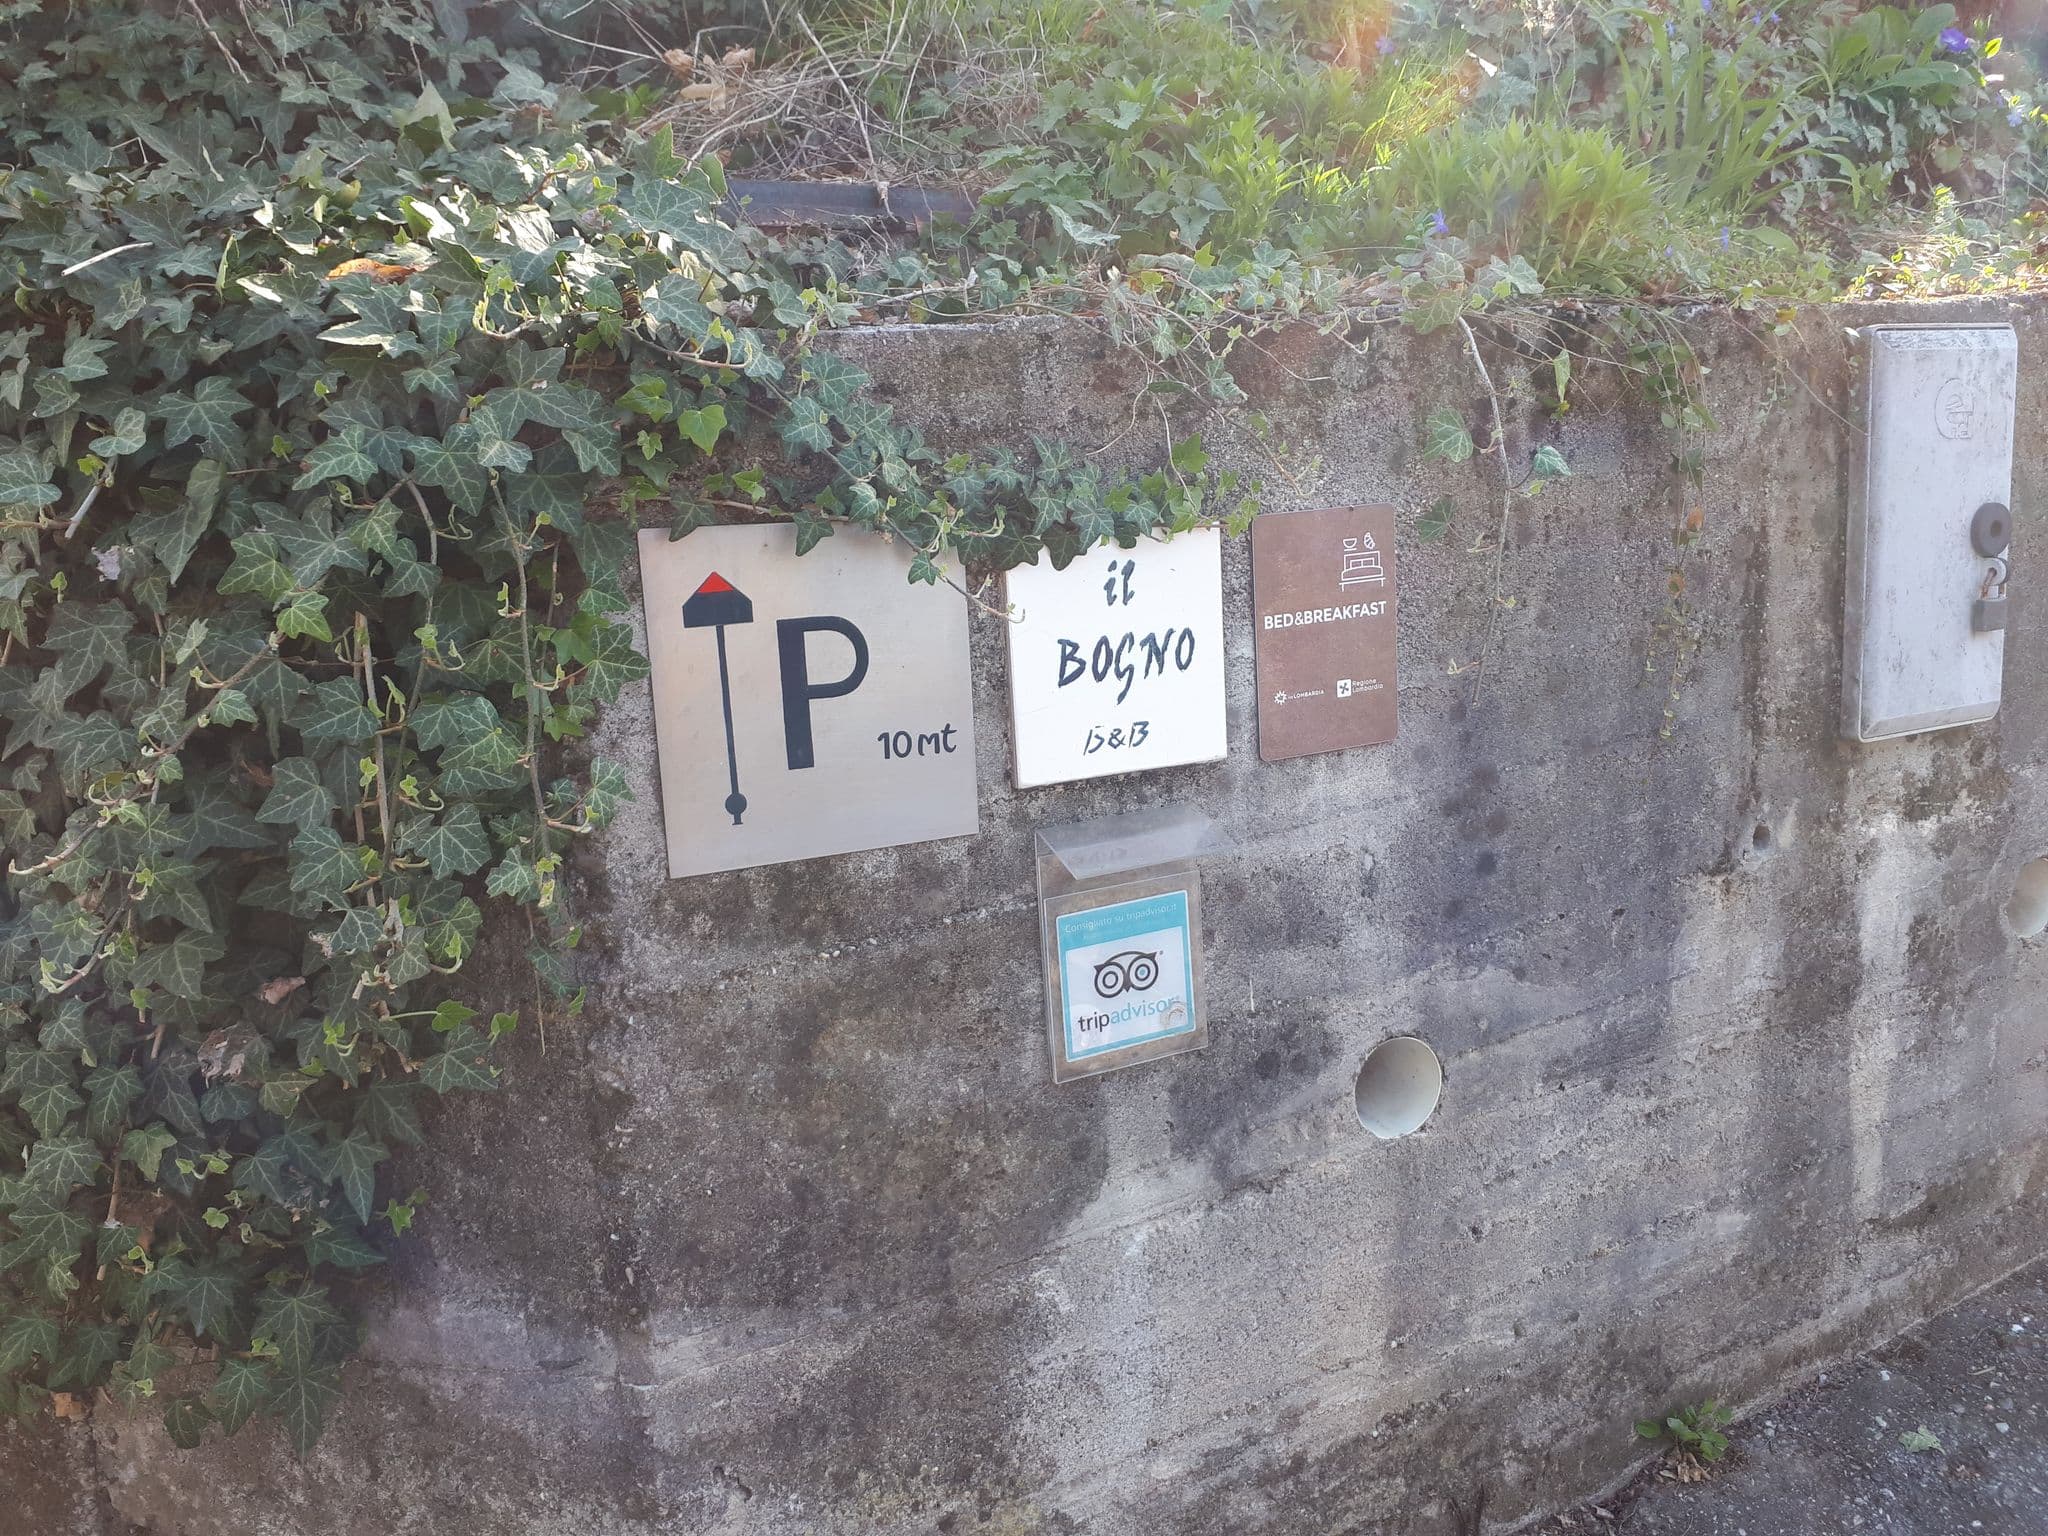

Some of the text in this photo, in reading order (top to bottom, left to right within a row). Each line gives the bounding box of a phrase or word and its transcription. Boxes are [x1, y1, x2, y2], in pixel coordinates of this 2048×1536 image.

[1103, 559, 1136, 606] il
[1264, 601, 1387, 630] BED&BREAKFAST
[1057, 626, 1196, 704] BOGNO
[776, 615, 869, 770] P
[1352, 678, 1376, 687] Regione
[1352, 683, 1384, 694] Lombardia
[1083, 720, 1149, 755] B&B
[1115, 914, 1124, 923] su
